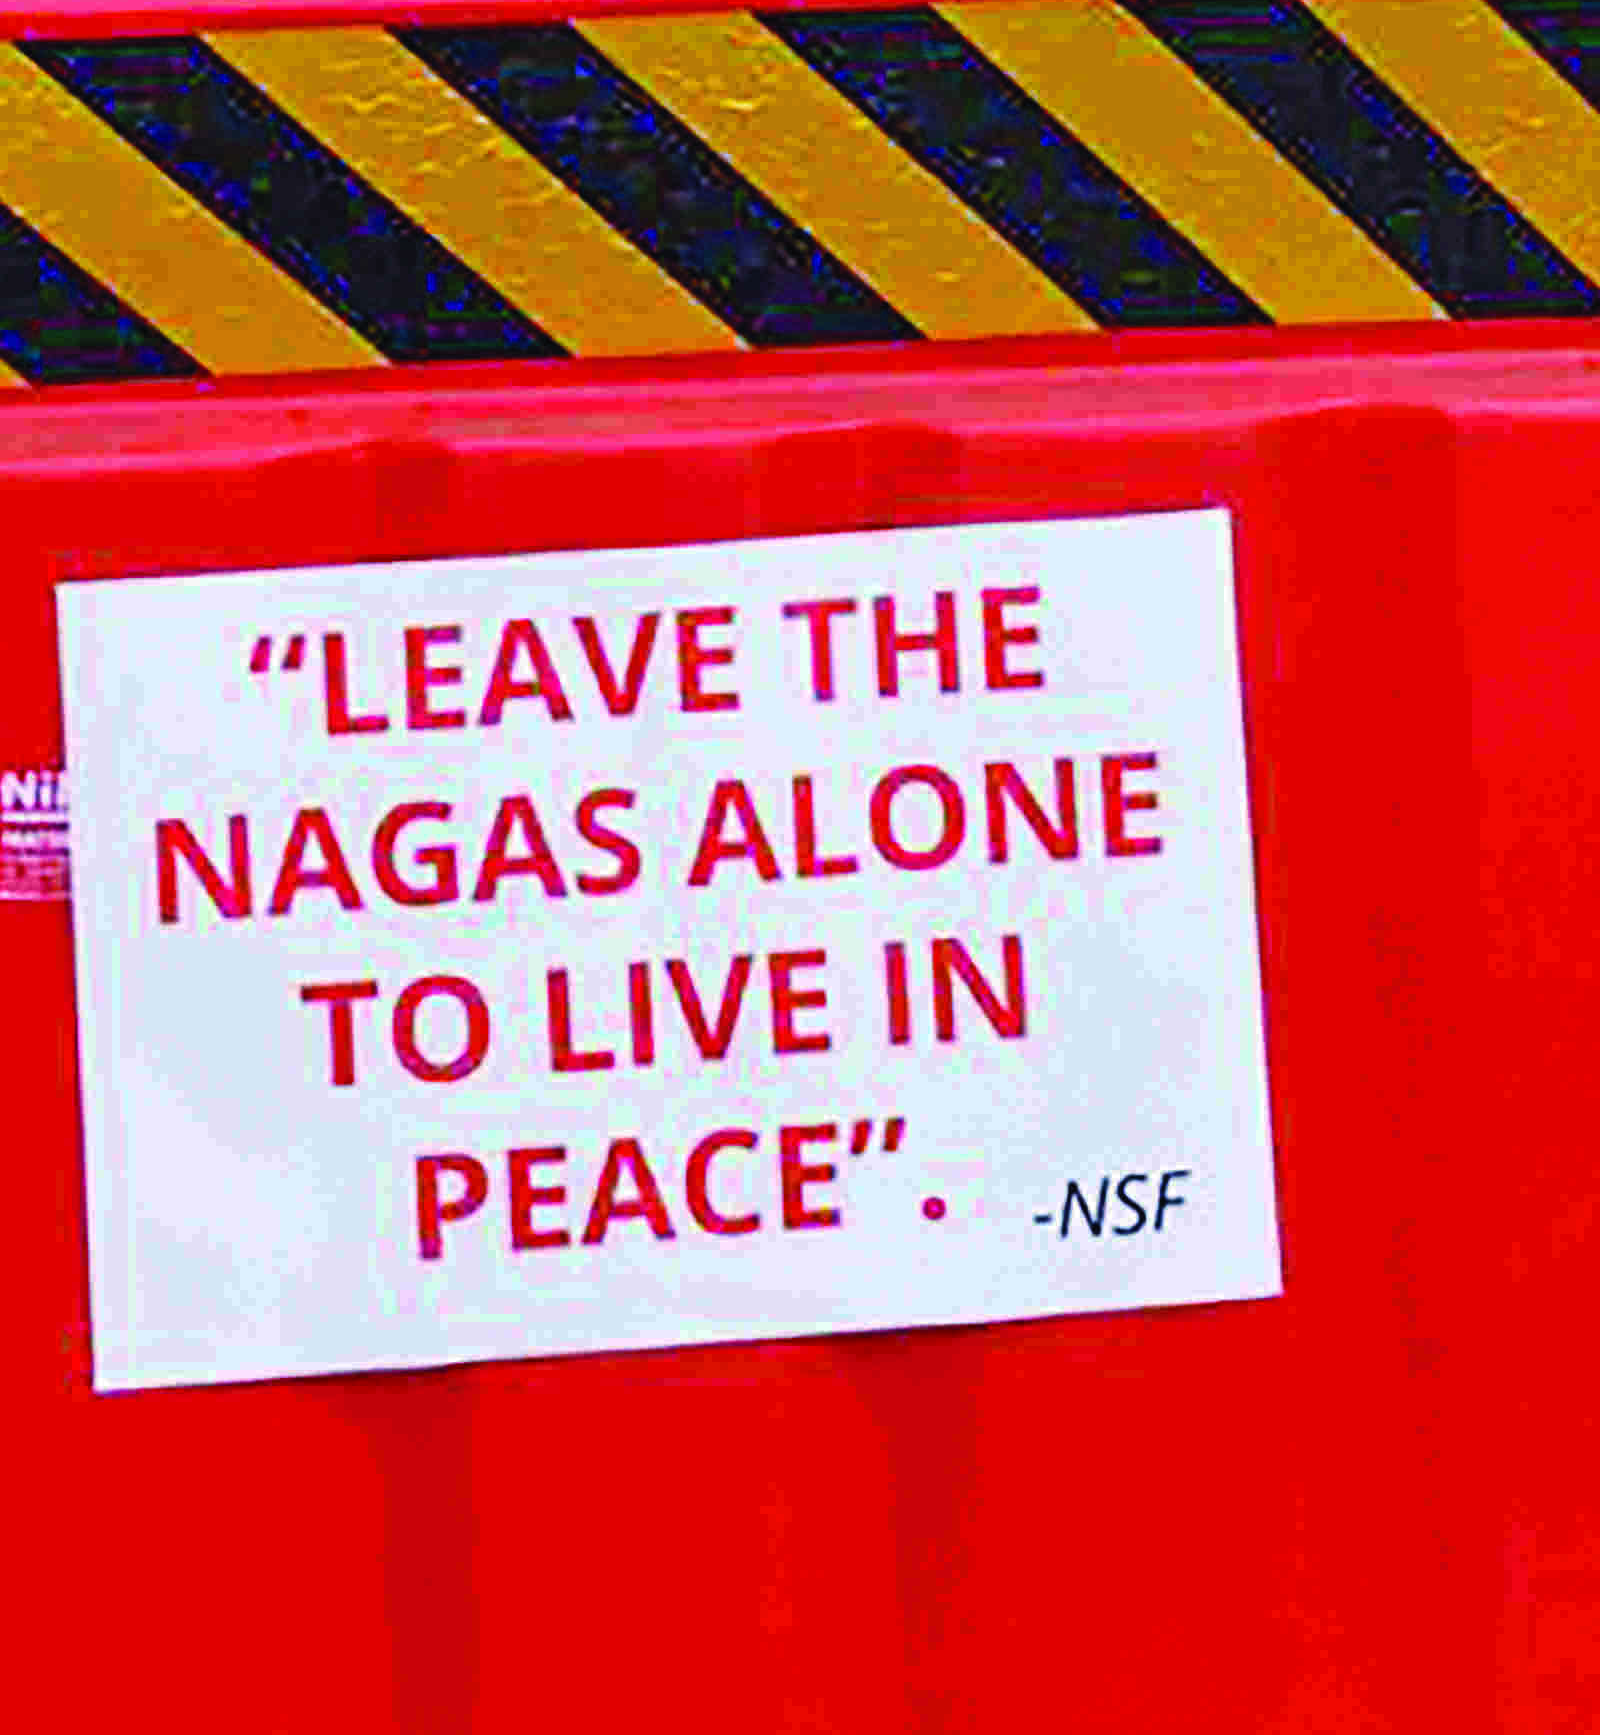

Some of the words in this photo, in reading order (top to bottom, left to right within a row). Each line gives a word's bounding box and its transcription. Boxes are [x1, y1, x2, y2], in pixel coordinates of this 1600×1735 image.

[250, 608, 737, 735] “LEAVE
[783, 590, 1042, 700] THE
[157, 781, 640, 923] NAGAS
[688, 755, 1160, 885] ALONE
[301, 976, 489, 1085] TO
[548, 950, 829, 1072] LIVE
[888, 935, 1025, 1044] IN
[1034, 1170, 1190, 1238] -NSF
